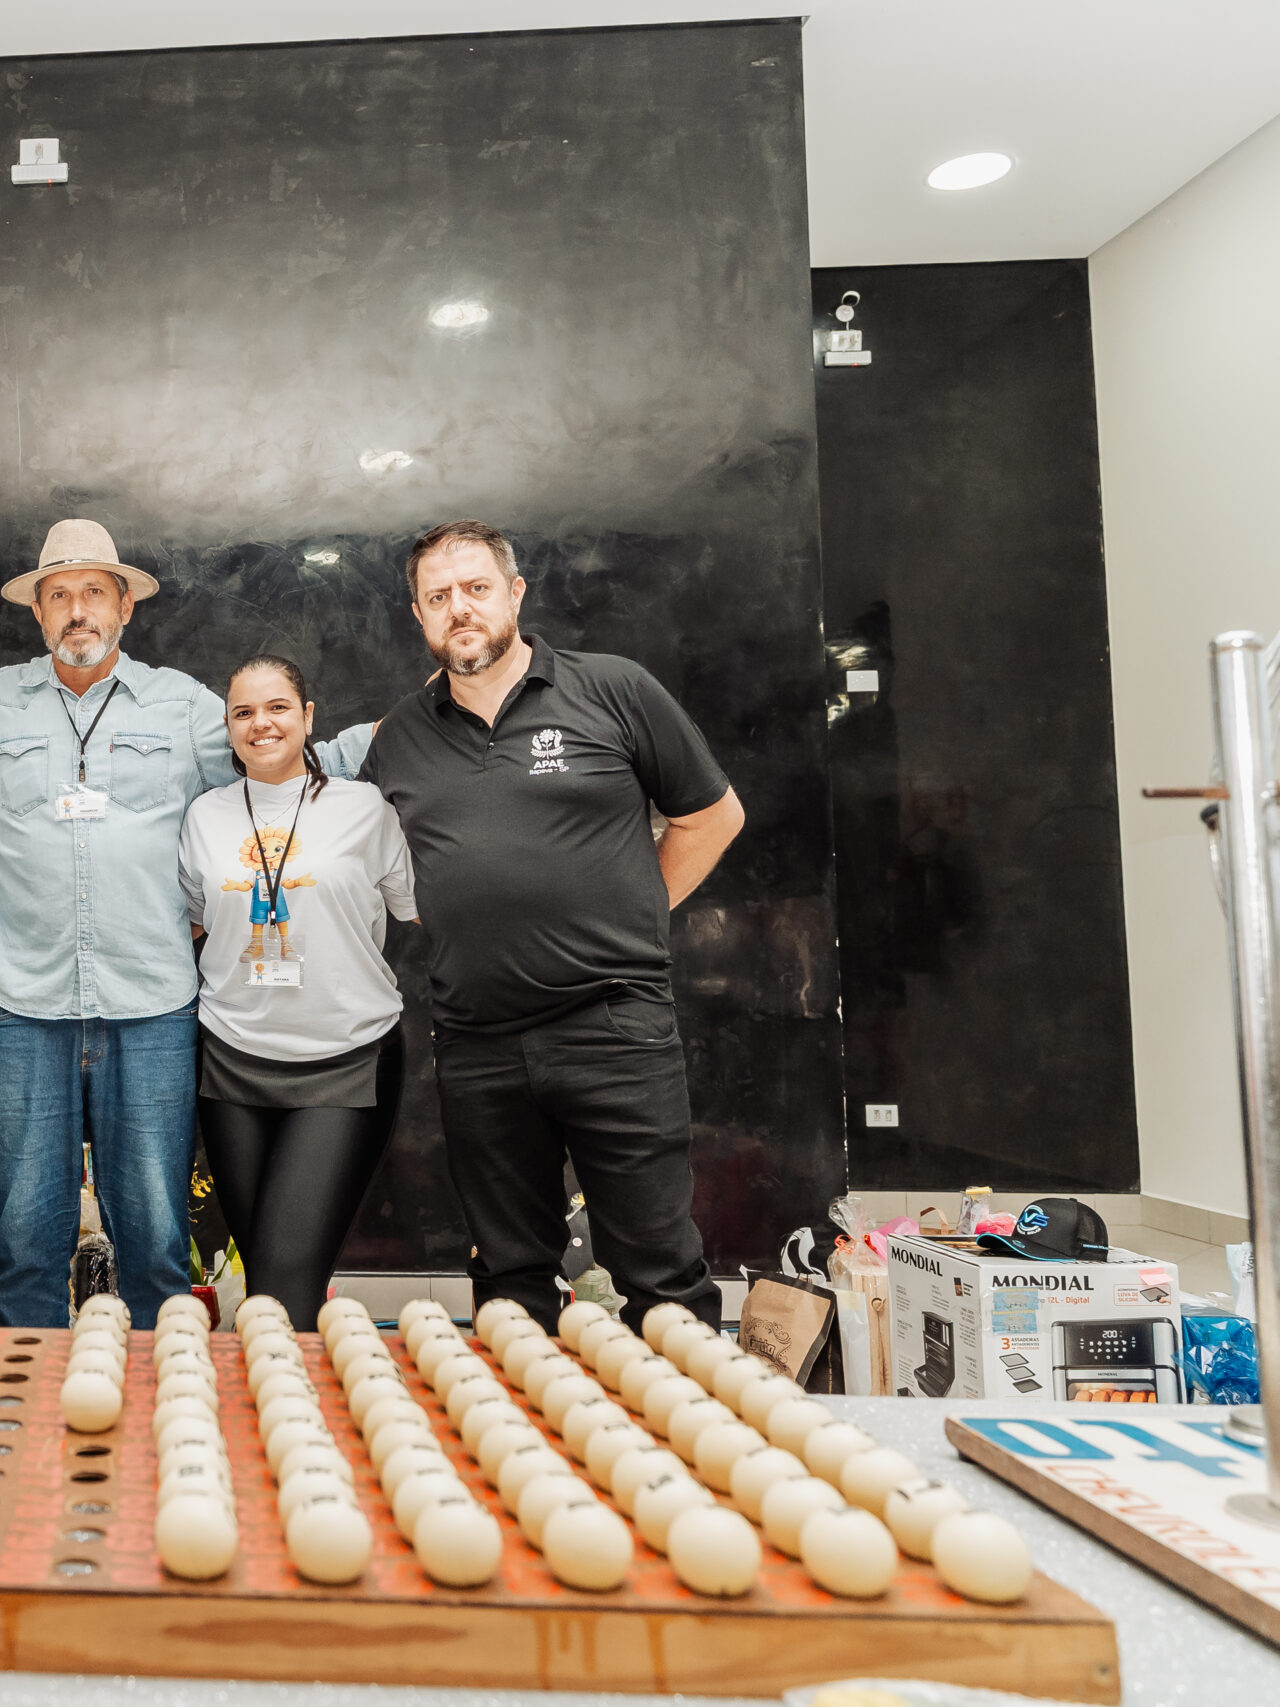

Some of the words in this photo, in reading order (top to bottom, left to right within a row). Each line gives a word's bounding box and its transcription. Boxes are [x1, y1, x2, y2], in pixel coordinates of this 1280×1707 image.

[533, 759, 565, 769] APAE
[891, 1245, 943, 1277] MONDIAL
[992, 1275, 1095, 1291] MONDIAL
[1065, 1296, 1090, 1305] Digital
[1102, 1330, 1118, 1339] 200
[1001, 1337, 1010, 1350] 3
